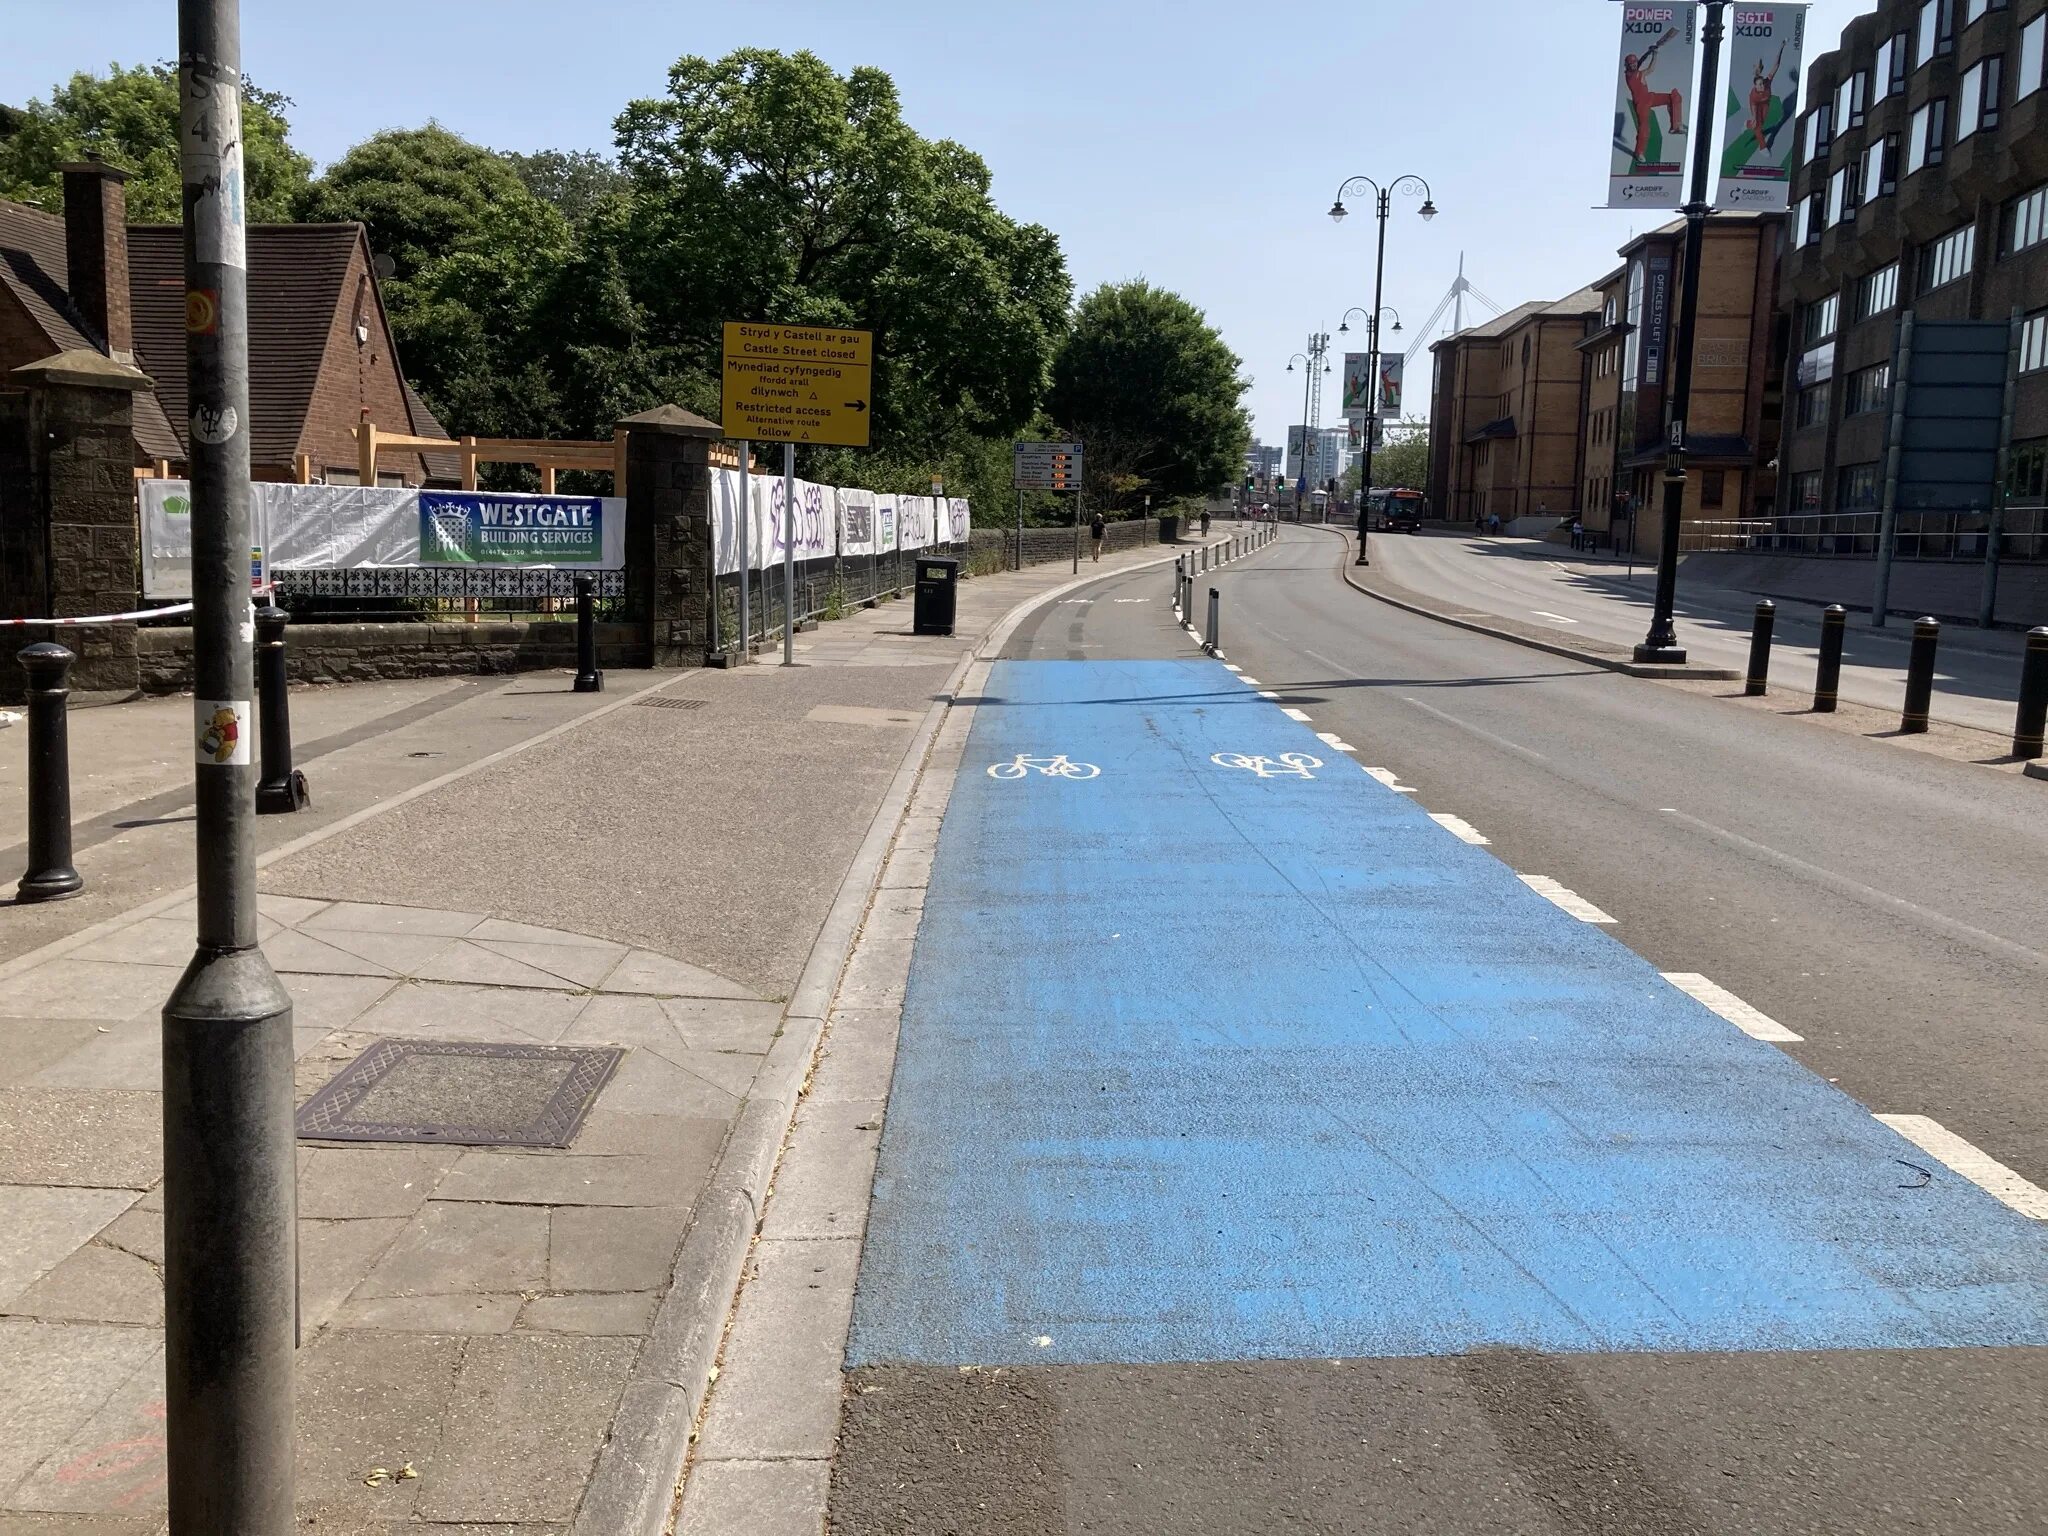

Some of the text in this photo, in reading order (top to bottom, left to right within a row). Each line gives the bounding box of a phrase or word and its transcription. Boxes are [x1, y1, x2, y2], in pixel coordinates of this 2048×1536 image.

[1626, 8, 1673, 21] POWER
[1736, 12, 1773, 25] SGIL
[1625, 22, 1662, 34] X100
[1685, 8, 1694, 45] HUNDRED
[1735, 25, 1772, 37] X100
[1794, 13, 1803, 51] HUNDRED
[192, 112, 210, 142] 4
[1742, 188, 1770, 196] CARDIFF
[1655, 274, 1665, 311] OFFICES
[1653, 312, 1662, 325] TO
[740, 326, 770, 338] Stryd
[773, 331, 780, 339] y
[783, 329, 822, 341] Castell
[840, 336, 860, 344] gau
[1652, 326, 1661, 342] LET
[743, 343, 856, 359] Castle Street closed
[727, 360, 842, 378] Mynediad cyfyngedig
[759, 375, 809, 386] ffordd arall
[750, 385, 799, 398] dilynwch
[735, 401, 831, 417] Restricted access
[746, 415, 821, 427] Alternative route
[757, 426, 791, 437] follow
[479, 502, 593, 526] WESTGATE
[480, 531, 593, 544] BUILDING SERVICES
